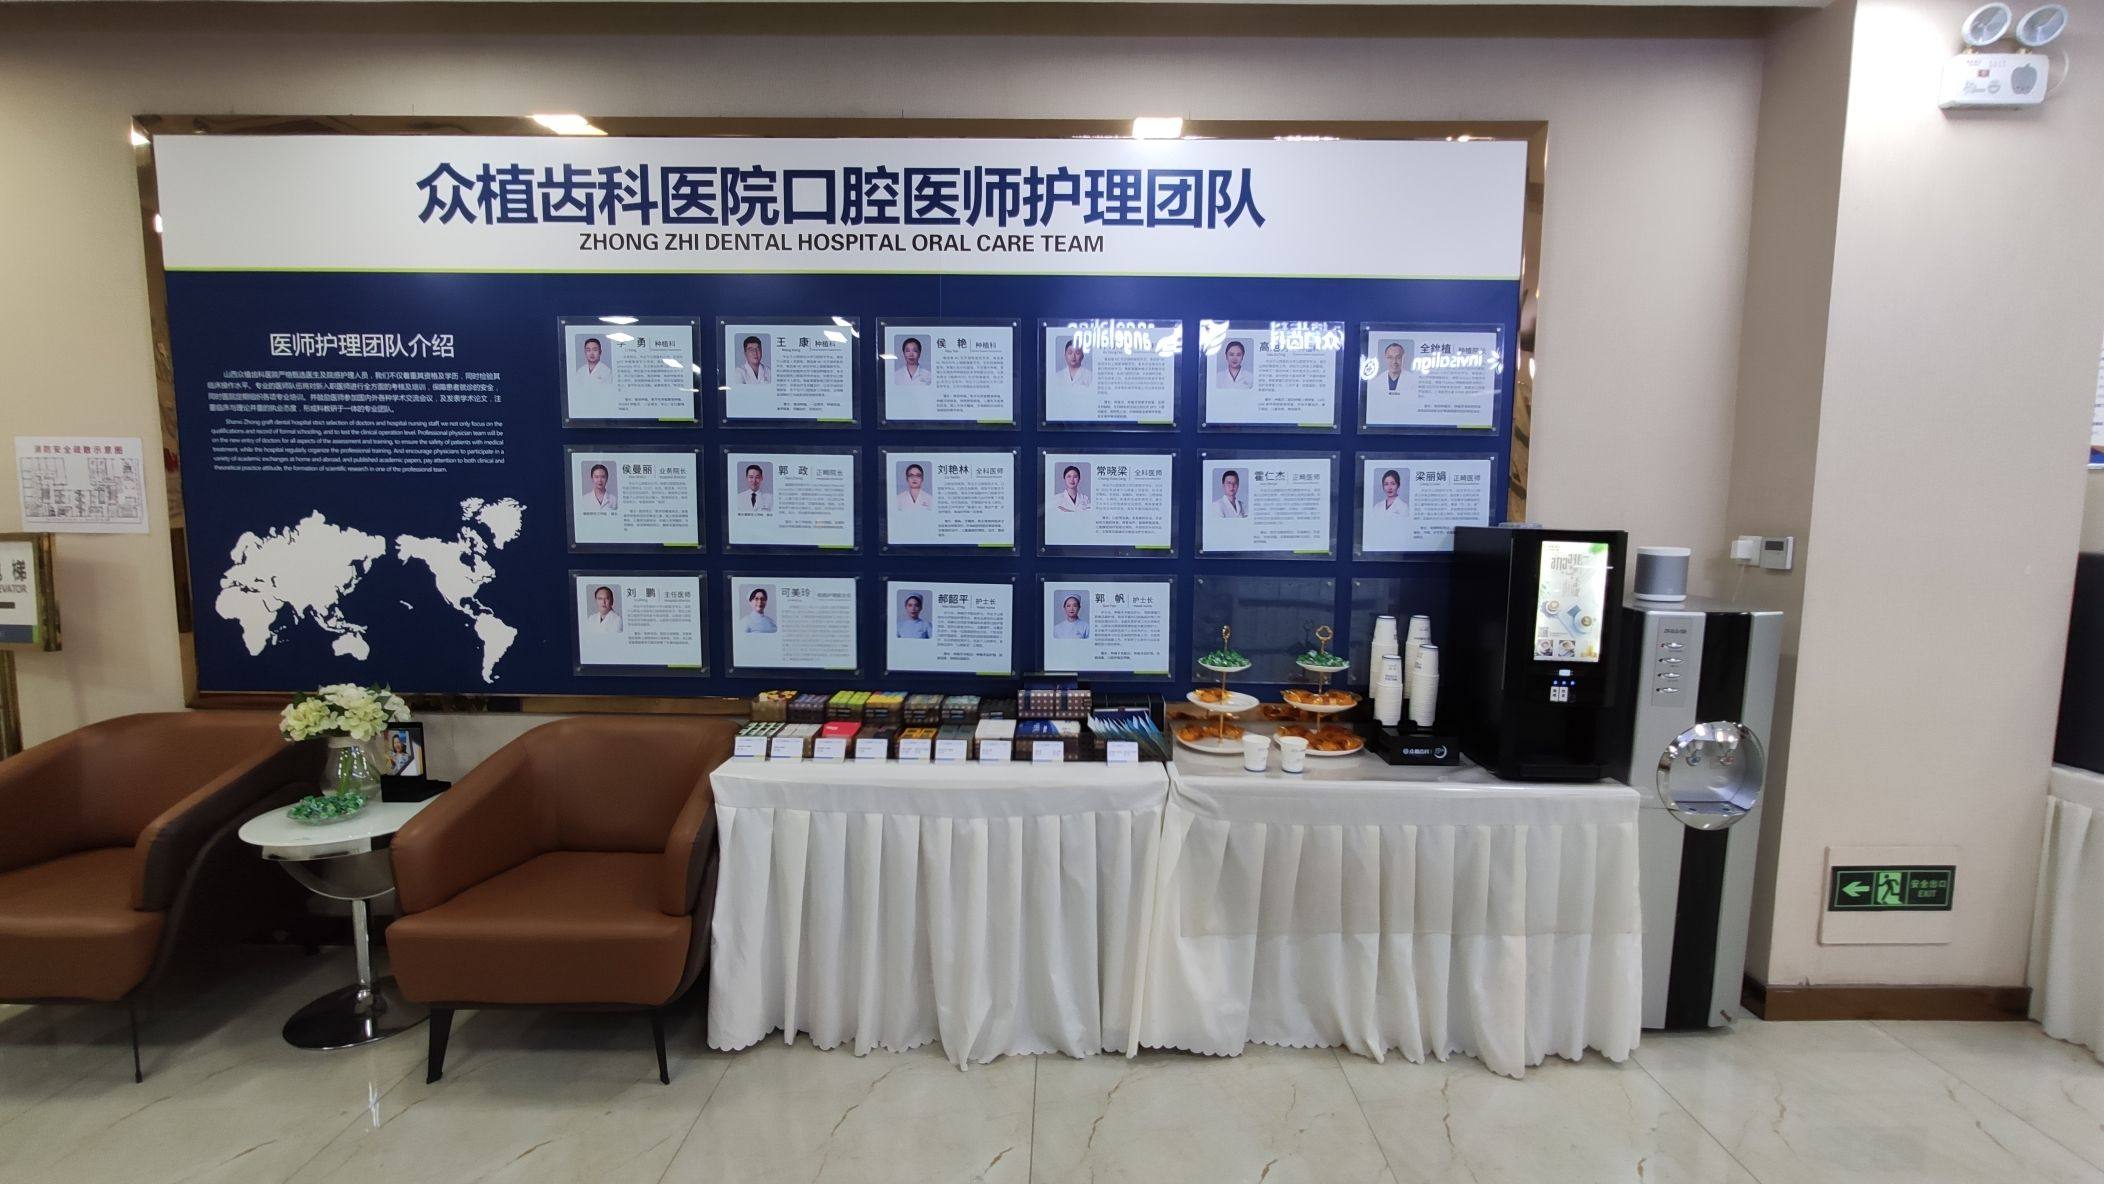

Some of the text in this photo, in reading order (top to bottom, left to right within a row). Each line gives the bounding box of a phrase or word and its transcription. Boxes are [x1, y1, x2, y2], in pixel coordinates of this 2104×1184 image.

[416, 162, 1266, 229] 众植齿科医院口腔医师护理团队
[580, 233, 1104, 253] ZHONG ZHI DENTAL HOSPITAL ORAL CARE TEAM
[270, 332, 455, 358] 医师护理团队介绍
[976, 467, 1004, 475] 全科医师
[1134, 469, 1162, 477] 全科医师
[664, 591, 691, 599] 主任医师
[1910, 880, 1947, 889] 安全出口
[1917, 889, 1937, 897] EXIT
